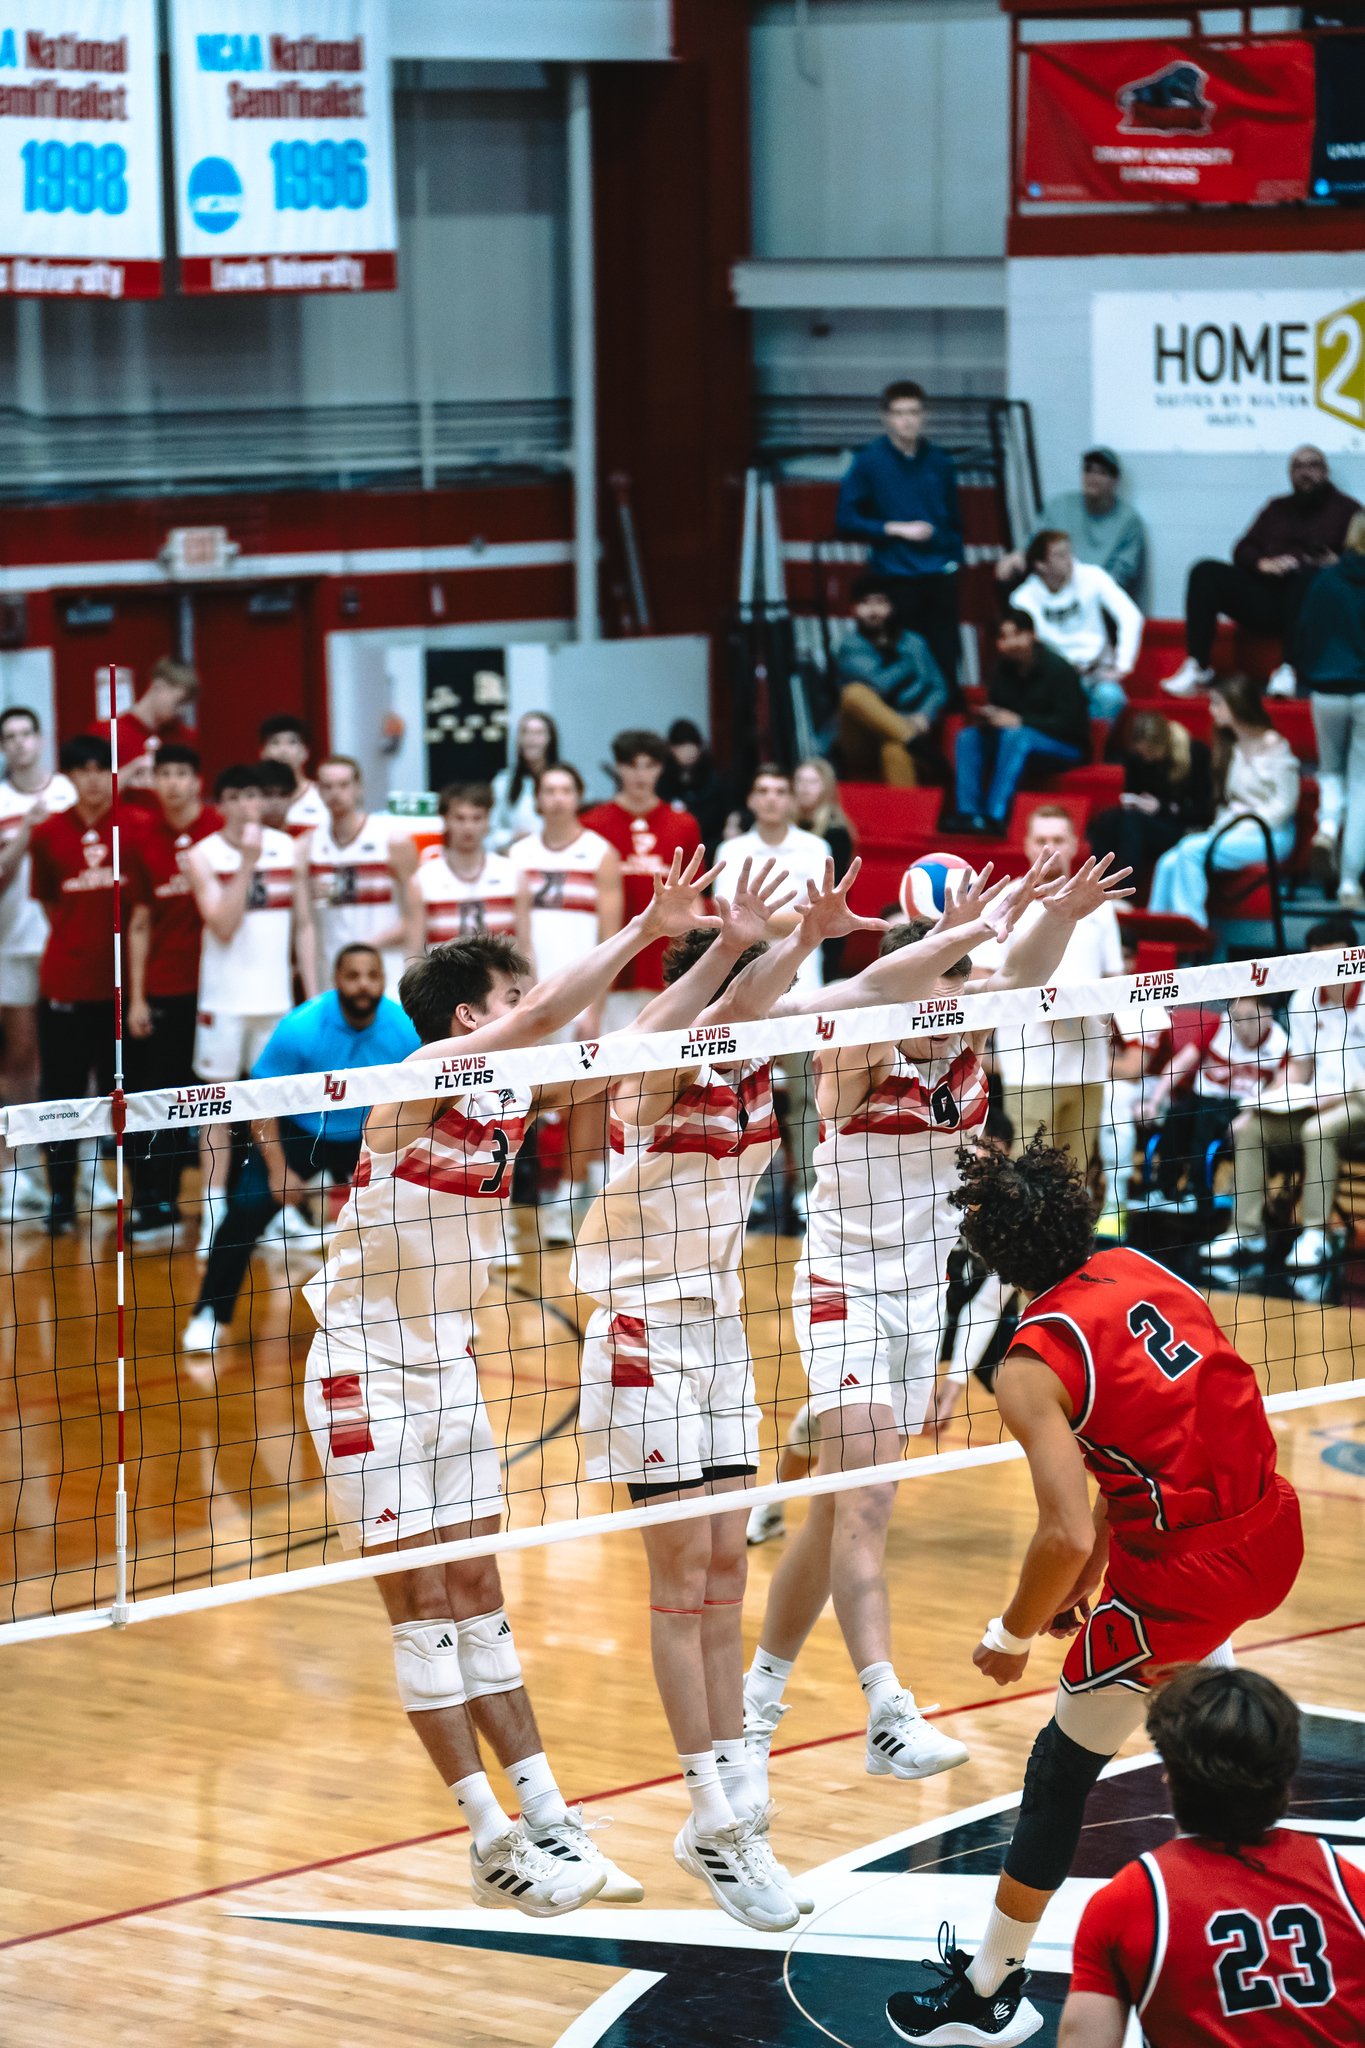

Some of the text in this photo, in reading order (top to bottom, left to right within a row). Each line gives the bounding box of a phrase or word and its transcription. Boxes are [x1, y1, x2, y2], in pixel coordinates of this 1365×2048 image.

[25, 29, 128, 73] National
[269, 33, 364, 73] National
[21, 140, 127, 215] 1998
[270, 139, 368, 211] 1996
[1154, 322, 1308, 384] HOME
[1135, 972, 1174, 988] LEWIS
[1130, 985, 1179, 1003] FLYERS
[919, 999, 957, 1014] LEWIS
[912, 1012, 964, 1030] FLYERS
[688, 1026, 730, 1043] LEWIS
[681, 1040, 736, 1059] FLYERS
[442, 1056, 486, 1073] LEWIS
[435, 1069, 493, 1090] FLYERS
[177, 1086, 226, 1103] LEWIS
[39, 1113, 55, 1121] sports
[167, 1100, 232, 1120] FLYERS
[478, 1127, 509, 1194] 3
[1127, 1300, 1203, 1382] 2
[1205, 1903, 1336, 2017] 23
